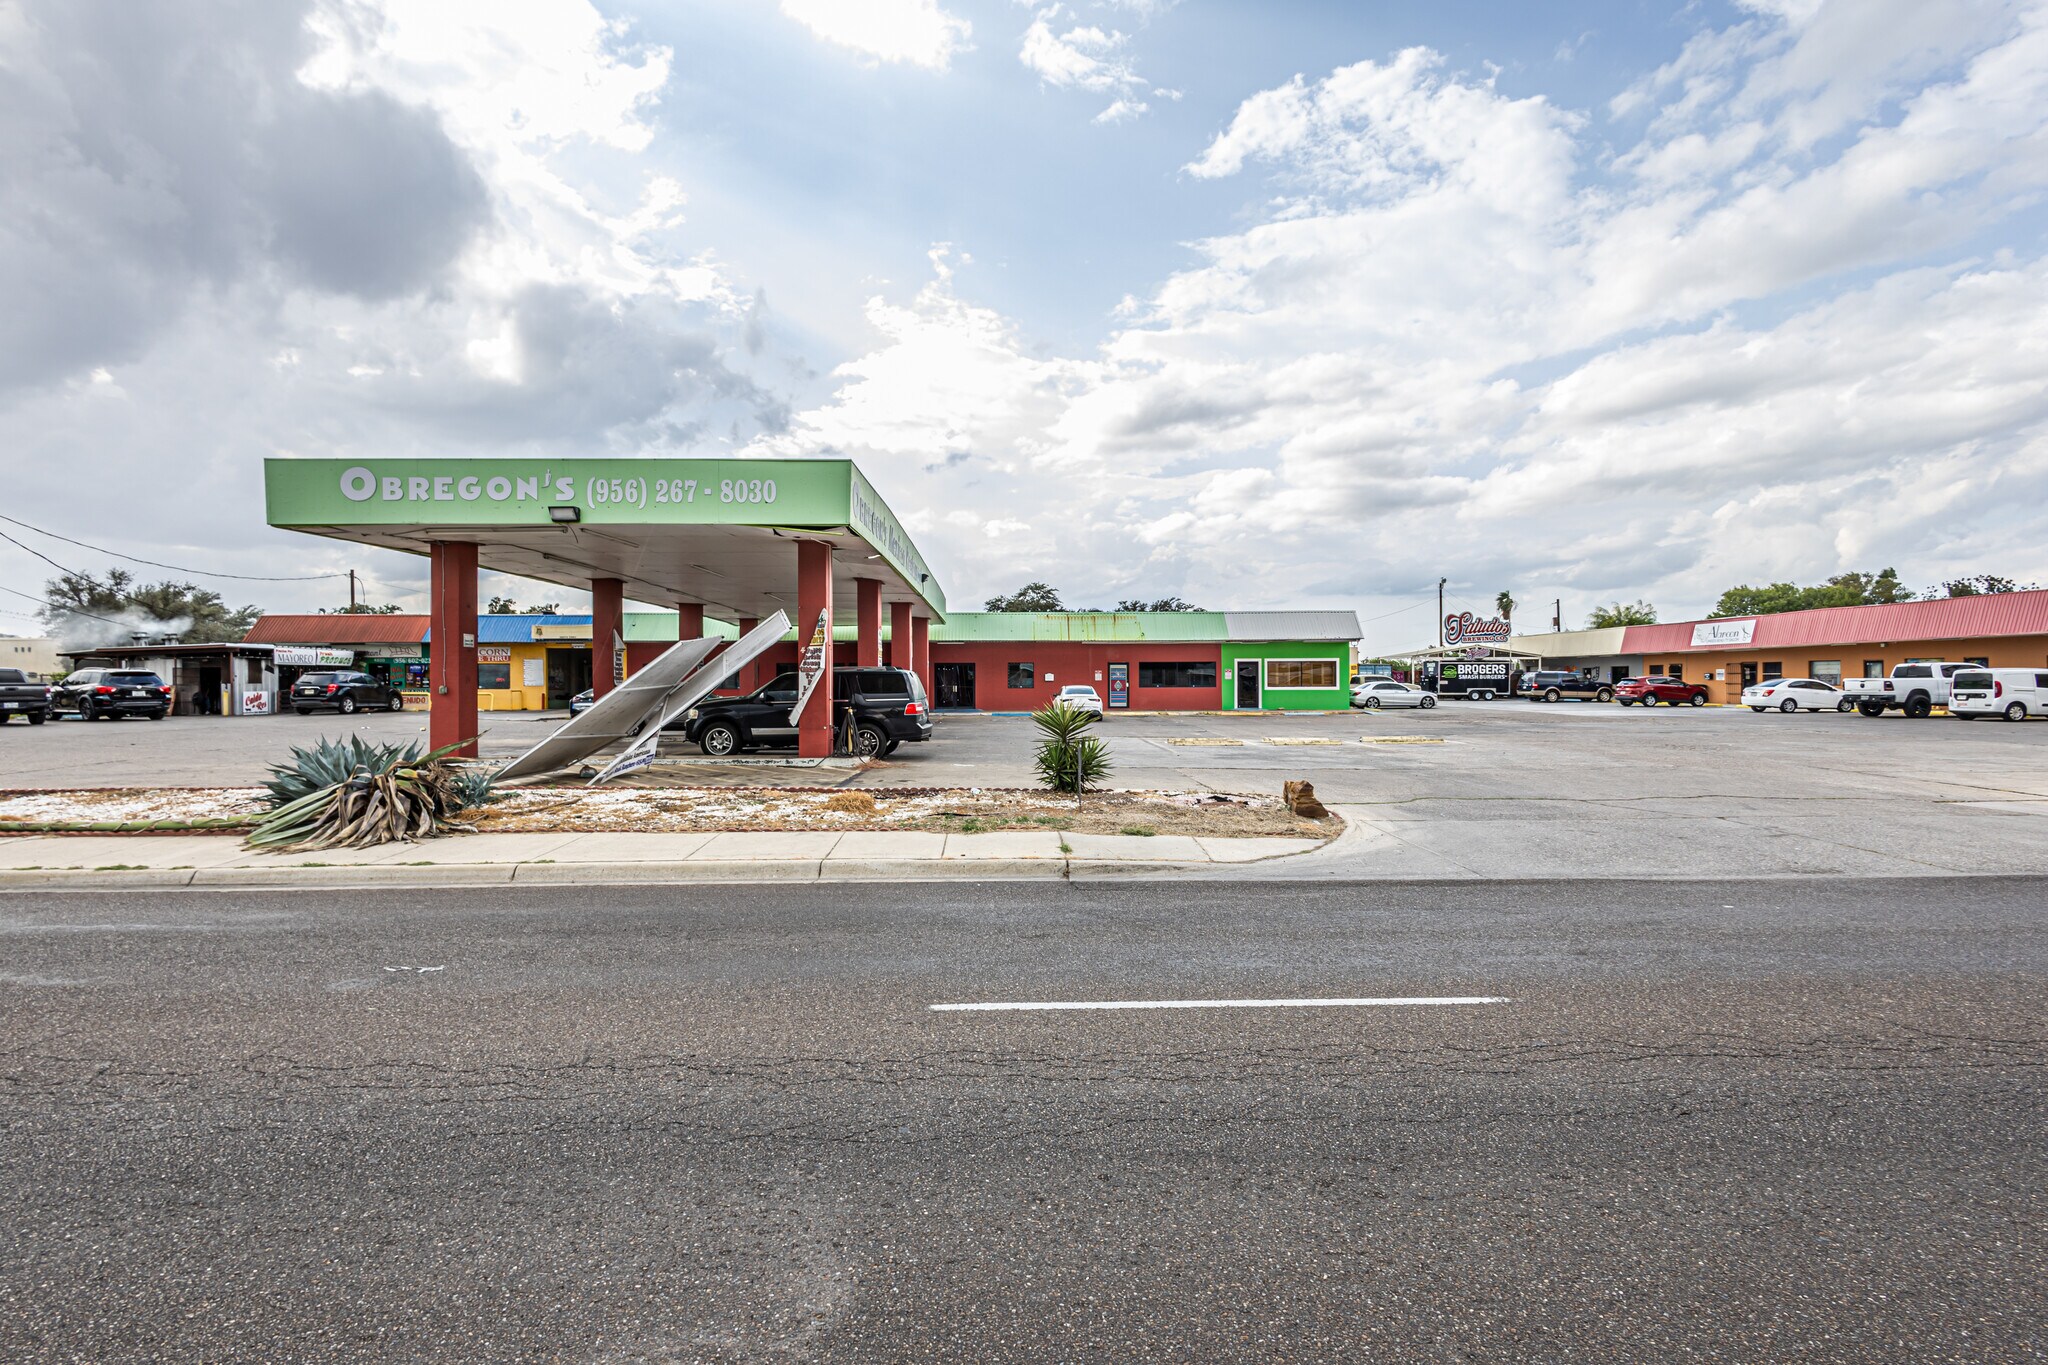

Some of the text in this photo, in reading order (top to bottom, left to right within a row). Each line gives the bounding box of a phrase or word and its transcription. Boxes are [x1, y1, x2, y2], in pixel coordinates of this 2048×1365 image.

[339, 466, 576, 502] OBREGON'S
[587, 478, 648, 510] (956)
[655, 479, 698, 503] 267
[719, 479, 778, 504] 8030
[1445, 611, 1512, 645] Saludos
[478, 648, 509, 656] CORN
[277, 653, 314, 664] MAYOREO
[1457, 664, 1506, 675] BROGERS
